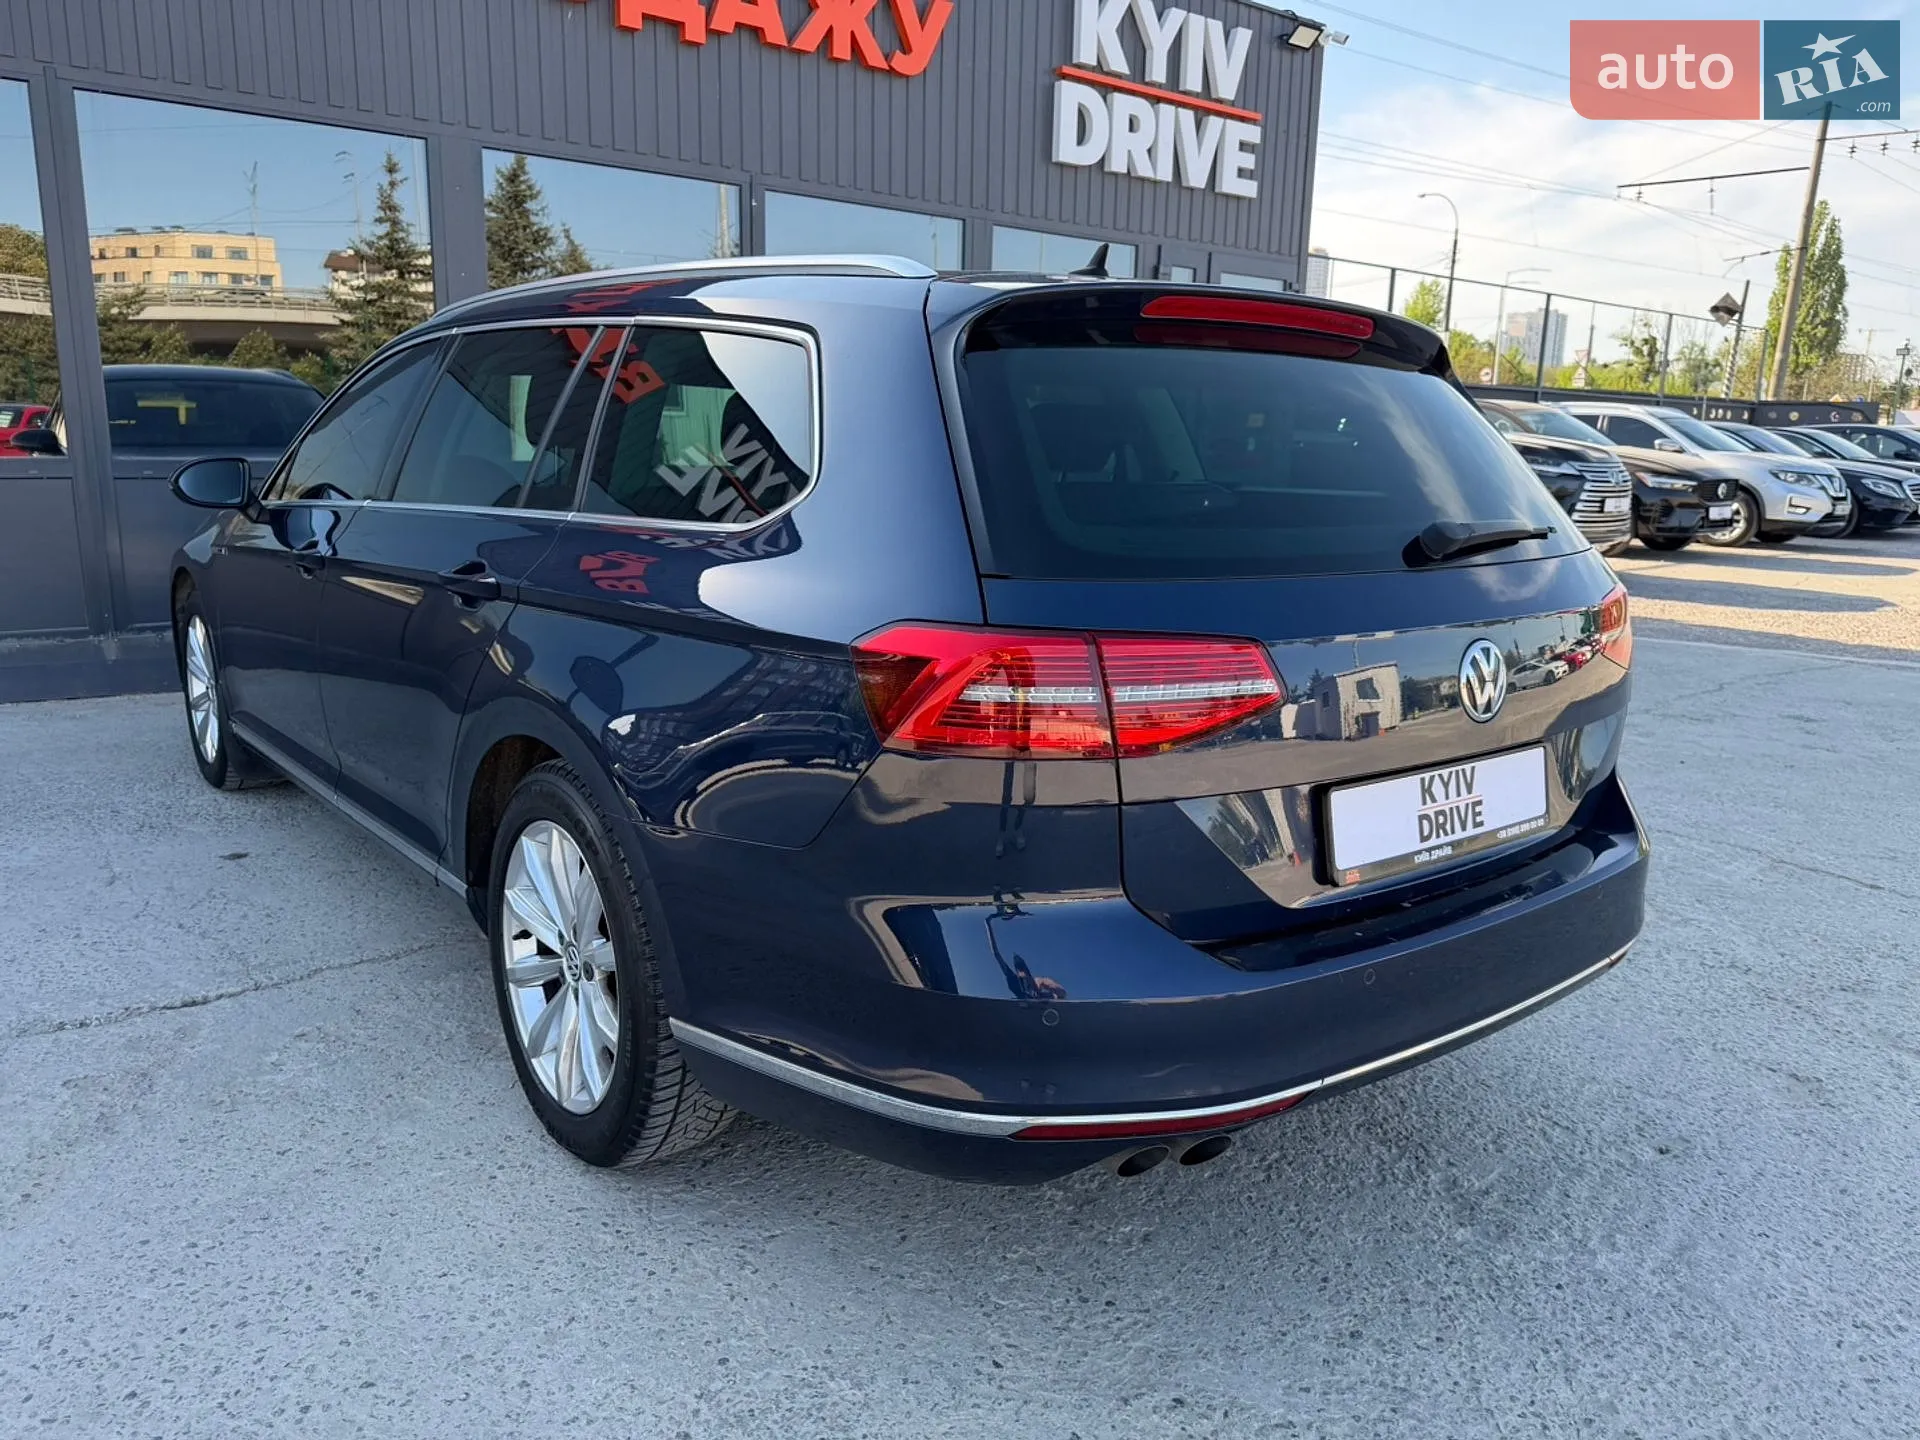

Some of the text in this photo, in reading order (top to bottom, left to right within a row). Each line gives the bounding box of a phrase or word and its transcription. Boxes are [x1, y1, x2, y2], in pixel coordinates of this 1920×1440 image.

[1072, 0, 1253, 101] KYIV
[1052, 79, 1262, 198] DRIVE
[1417, 799, 1485, 844] DRIVE
[1419, 765, 1476, 806] KYIV
